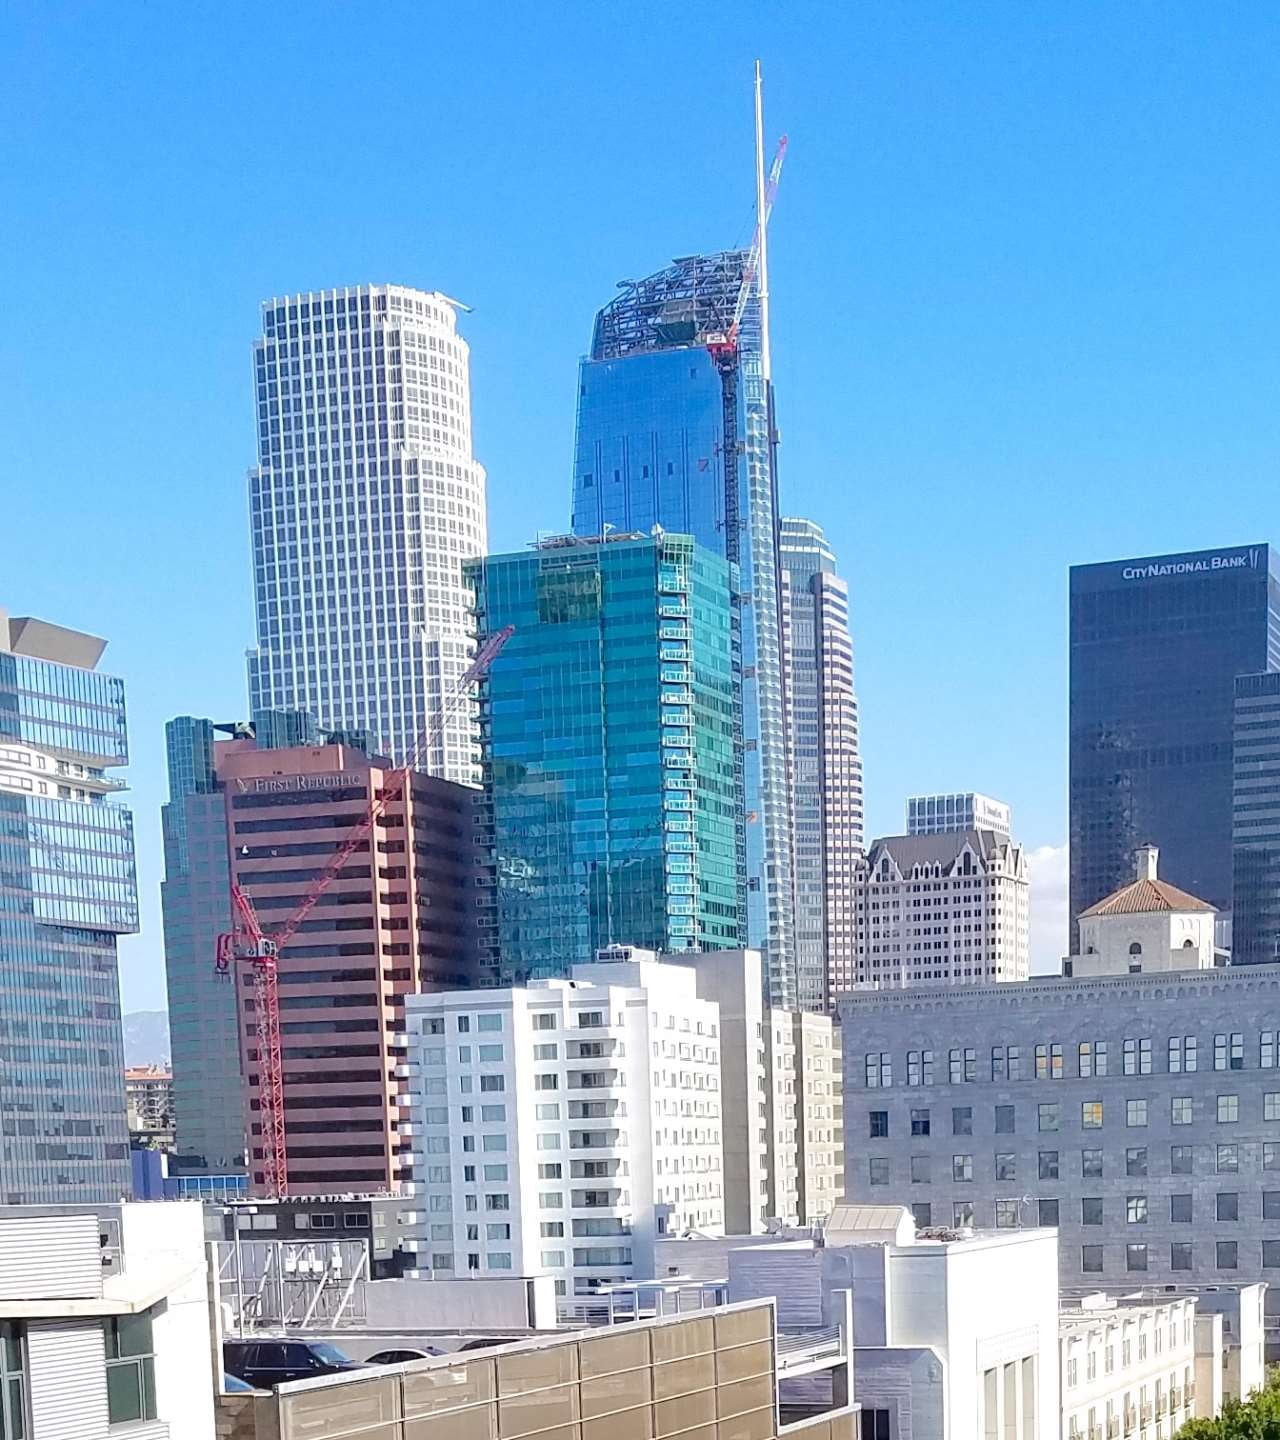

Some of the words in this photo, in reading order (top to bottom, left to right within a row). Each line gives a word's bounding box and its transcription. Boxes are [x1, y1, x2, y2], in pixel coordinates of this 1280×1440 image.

[1148, 560, 1209, 577] NATIONAL
[1211, 556, 1248, 569] BANK
[255, 778, 293, 792] FIRST
[296, 775, 361, 790] REPUBLIC
